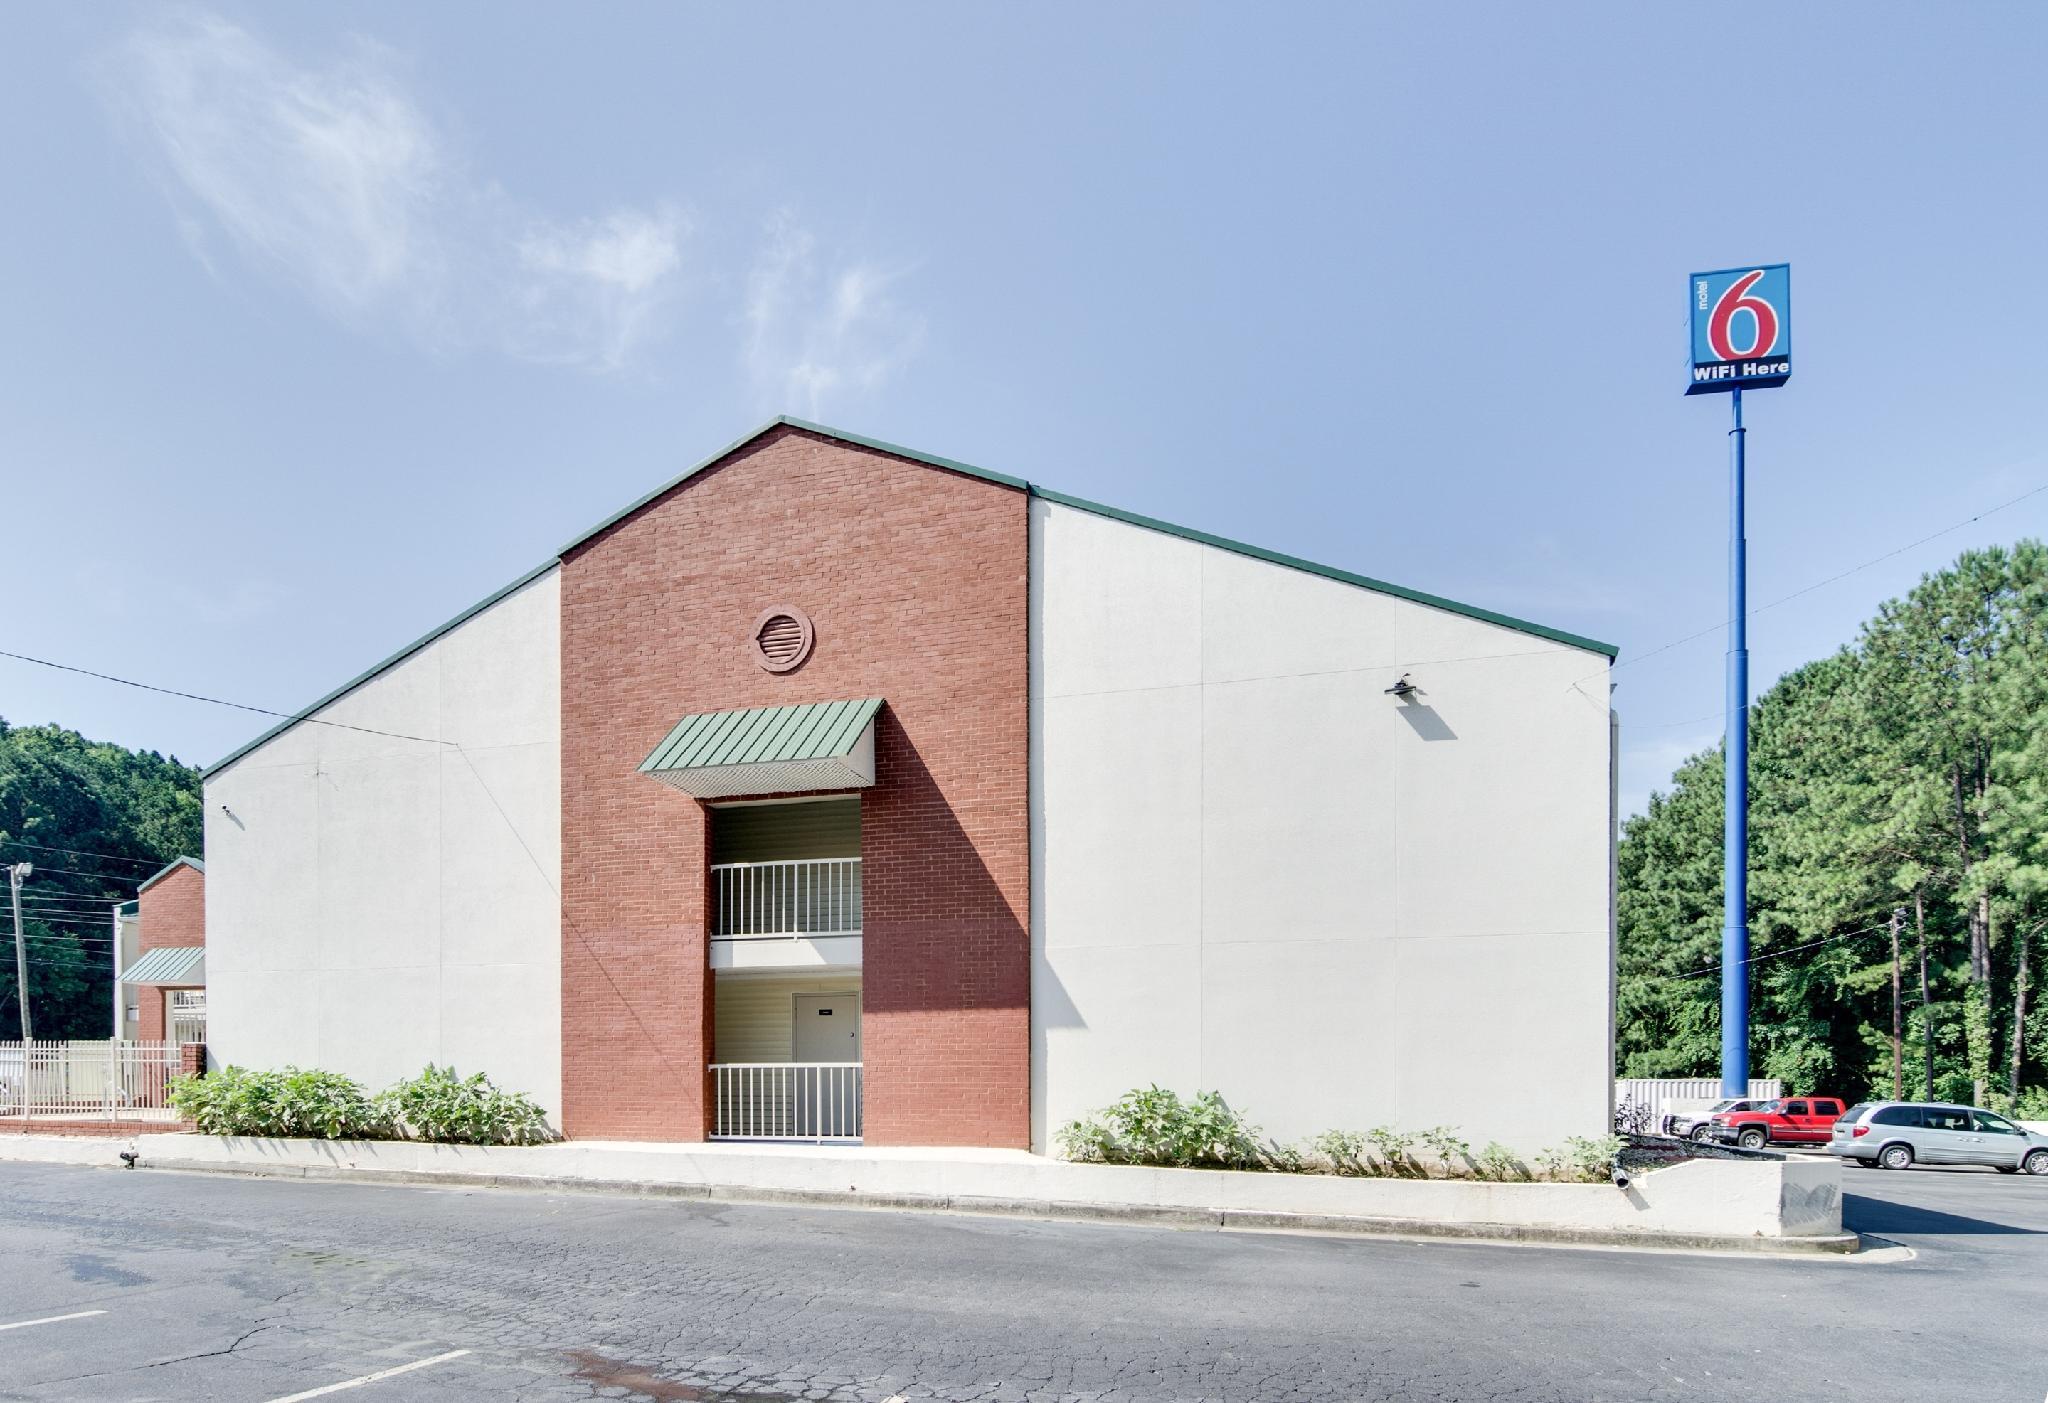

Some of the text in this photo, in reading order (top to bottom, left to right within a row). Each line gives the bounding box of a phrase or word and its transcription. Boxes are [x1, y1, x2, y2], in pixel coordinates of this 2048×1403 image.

[1696, 280, 1708, 310] motel
[1707, 269, 1779, 361] 6
[1694, 362, 1789, 381] WiFi Here
